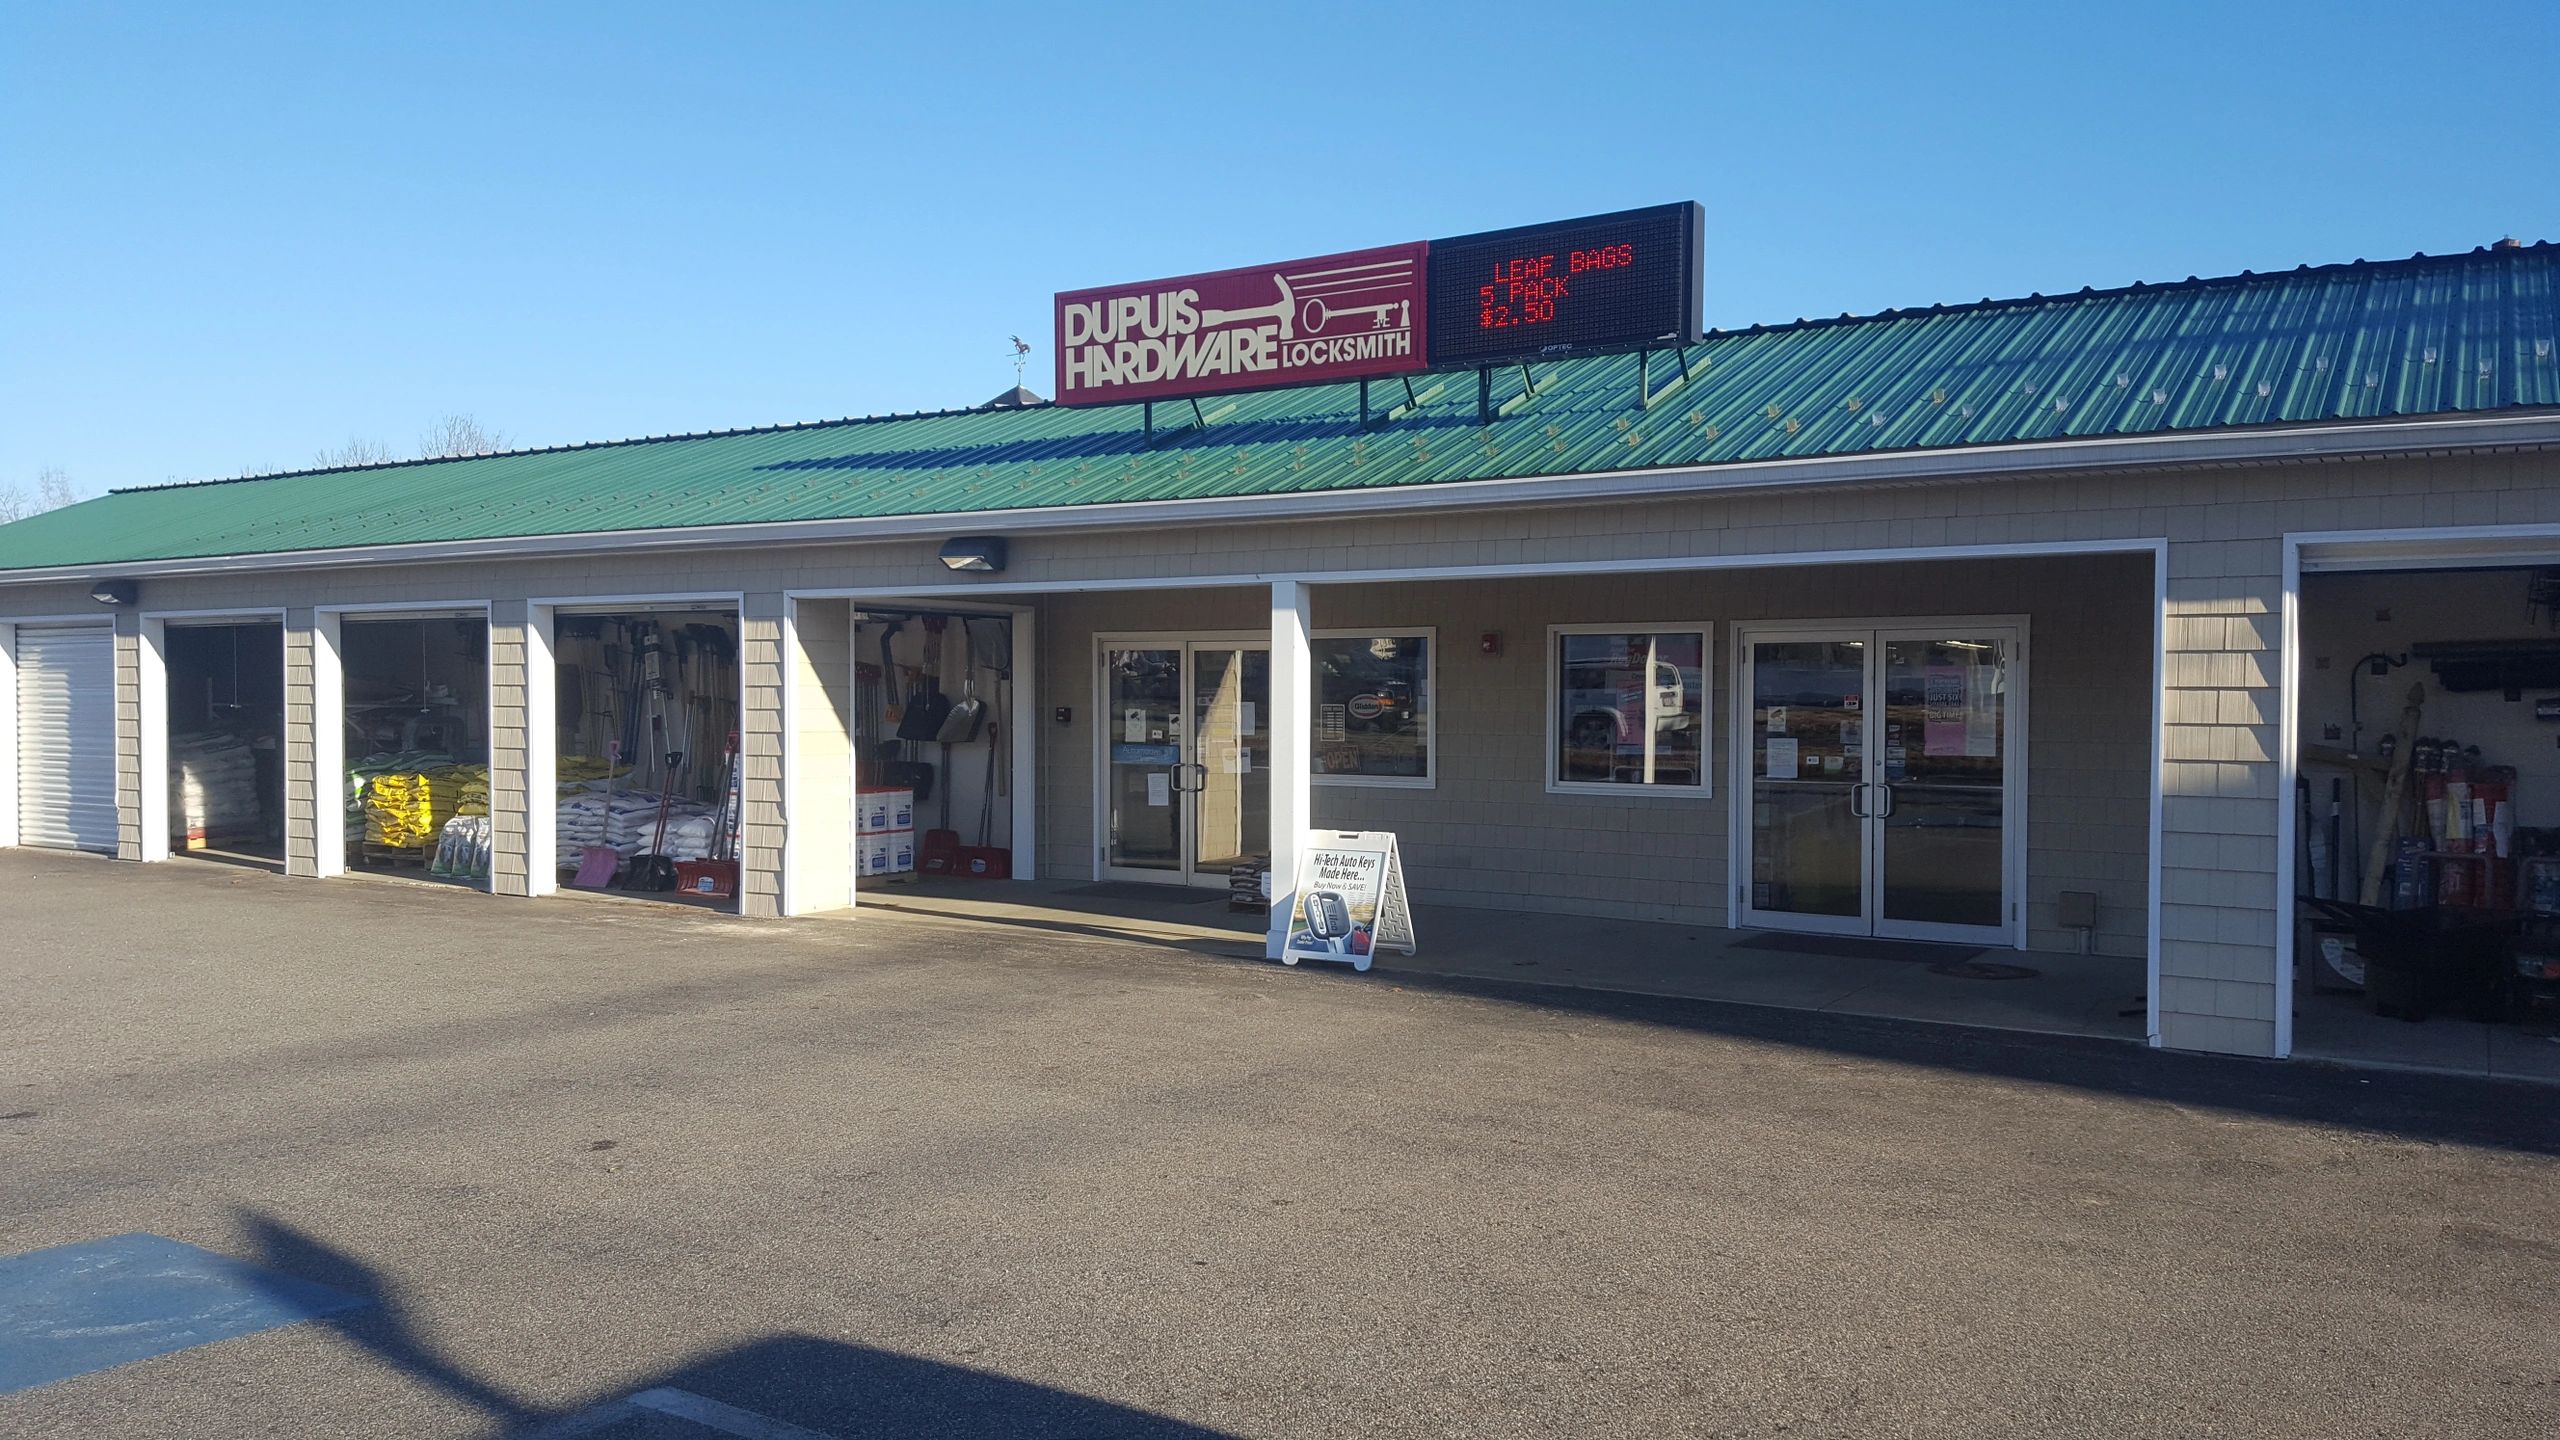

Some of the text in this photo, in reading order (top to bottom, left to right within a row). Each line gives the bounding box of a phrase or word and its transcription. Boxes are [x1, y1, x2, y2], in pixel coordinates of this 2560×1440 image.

[1494, 243, 1632, 283] LEAF BAGS
[1480, 275, 1569, 306] 5 PACK
[1065, 288, 1200, 347] DUPUIS
[1480, 299, 1555, 328] $2.50
[1065, 324, 1278, 390] HARDWARE
[1282, 331, 1412, 368] LOCKSMITH
[1547, 343, 1573, 351] OPTEC
[1327, 751, 1358, 769] OPEN
[1314, 853, 1376, 871] Hi-Tech Auto Keys
[1319, 867, 1365, 881] Made Here...
[1314, 881, 1326, 890] Buy
[1326, 882, 1342, 890] Now
[1347, 884, 1367, 892] SAVE!
